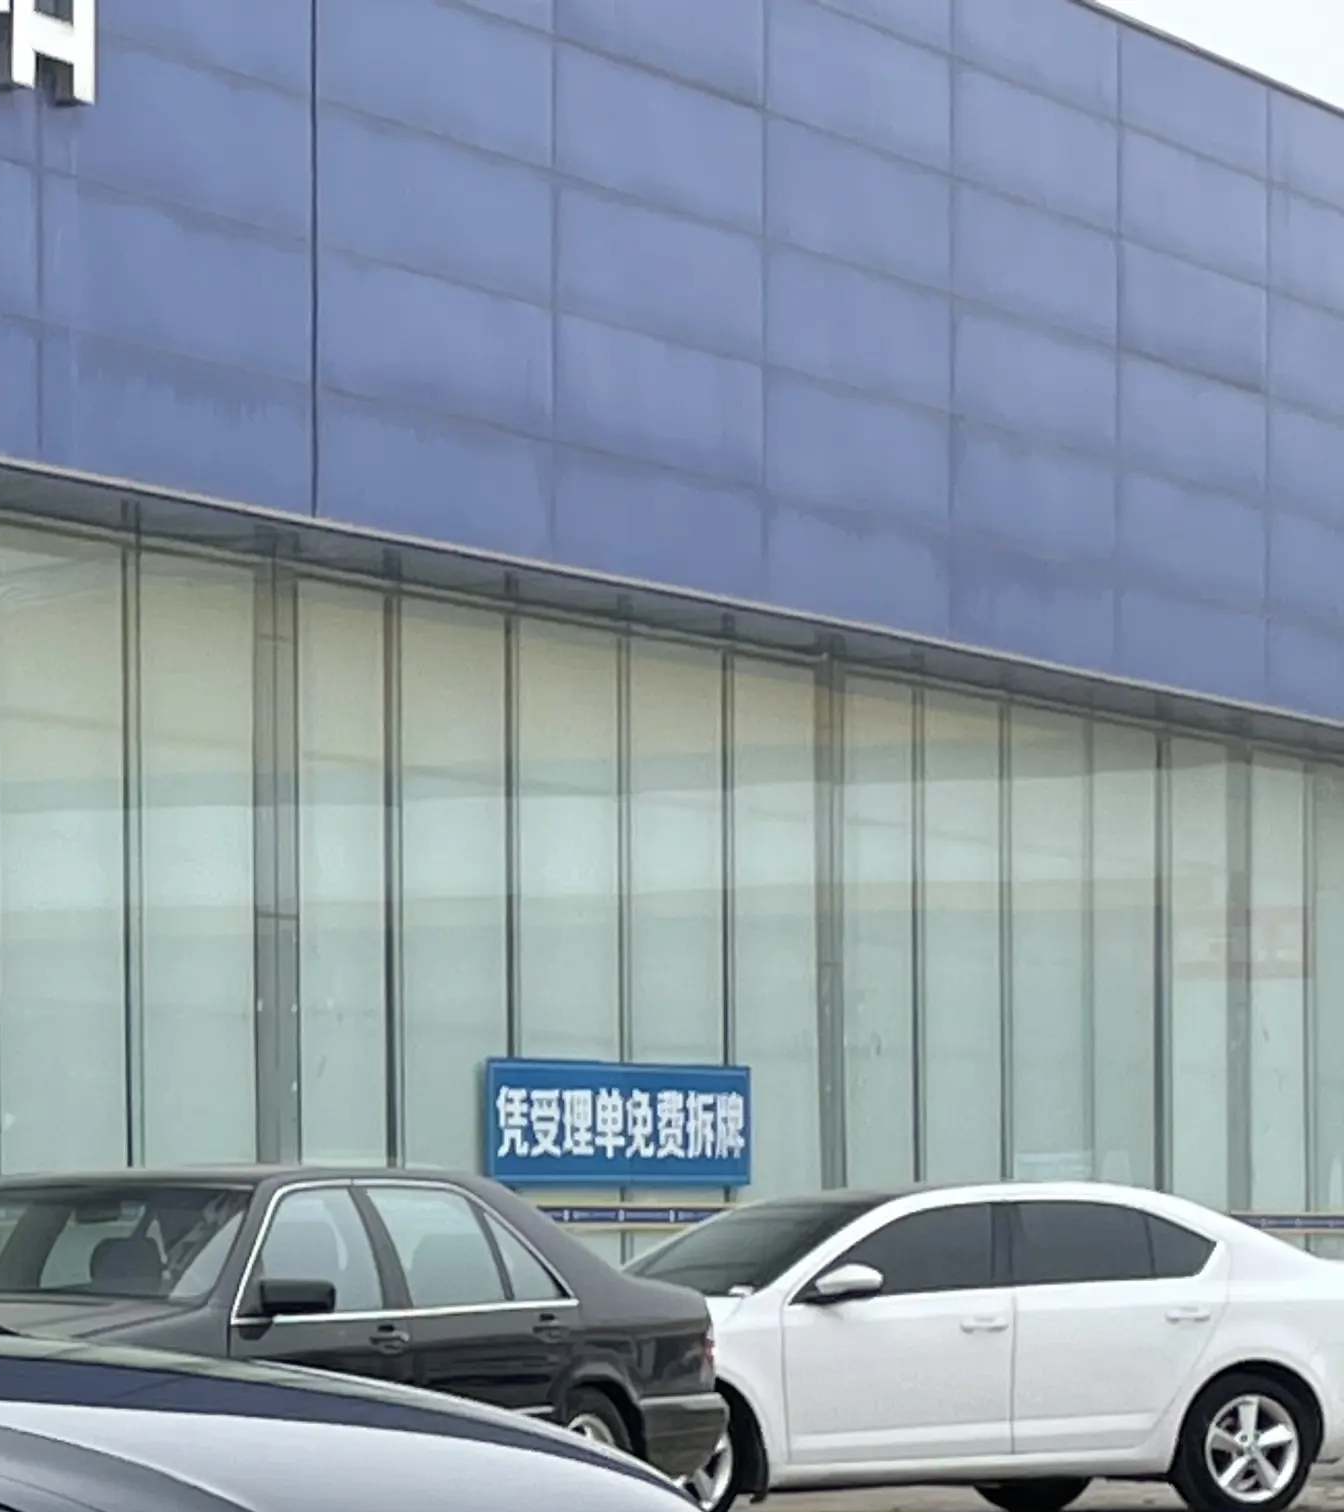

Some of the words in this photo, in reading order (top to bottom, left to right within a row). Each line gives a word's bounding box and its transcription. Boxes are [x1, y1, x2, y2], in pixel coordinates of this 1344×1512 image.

[496, 1085, 745, 1160] 凭受理单免费拆牌
